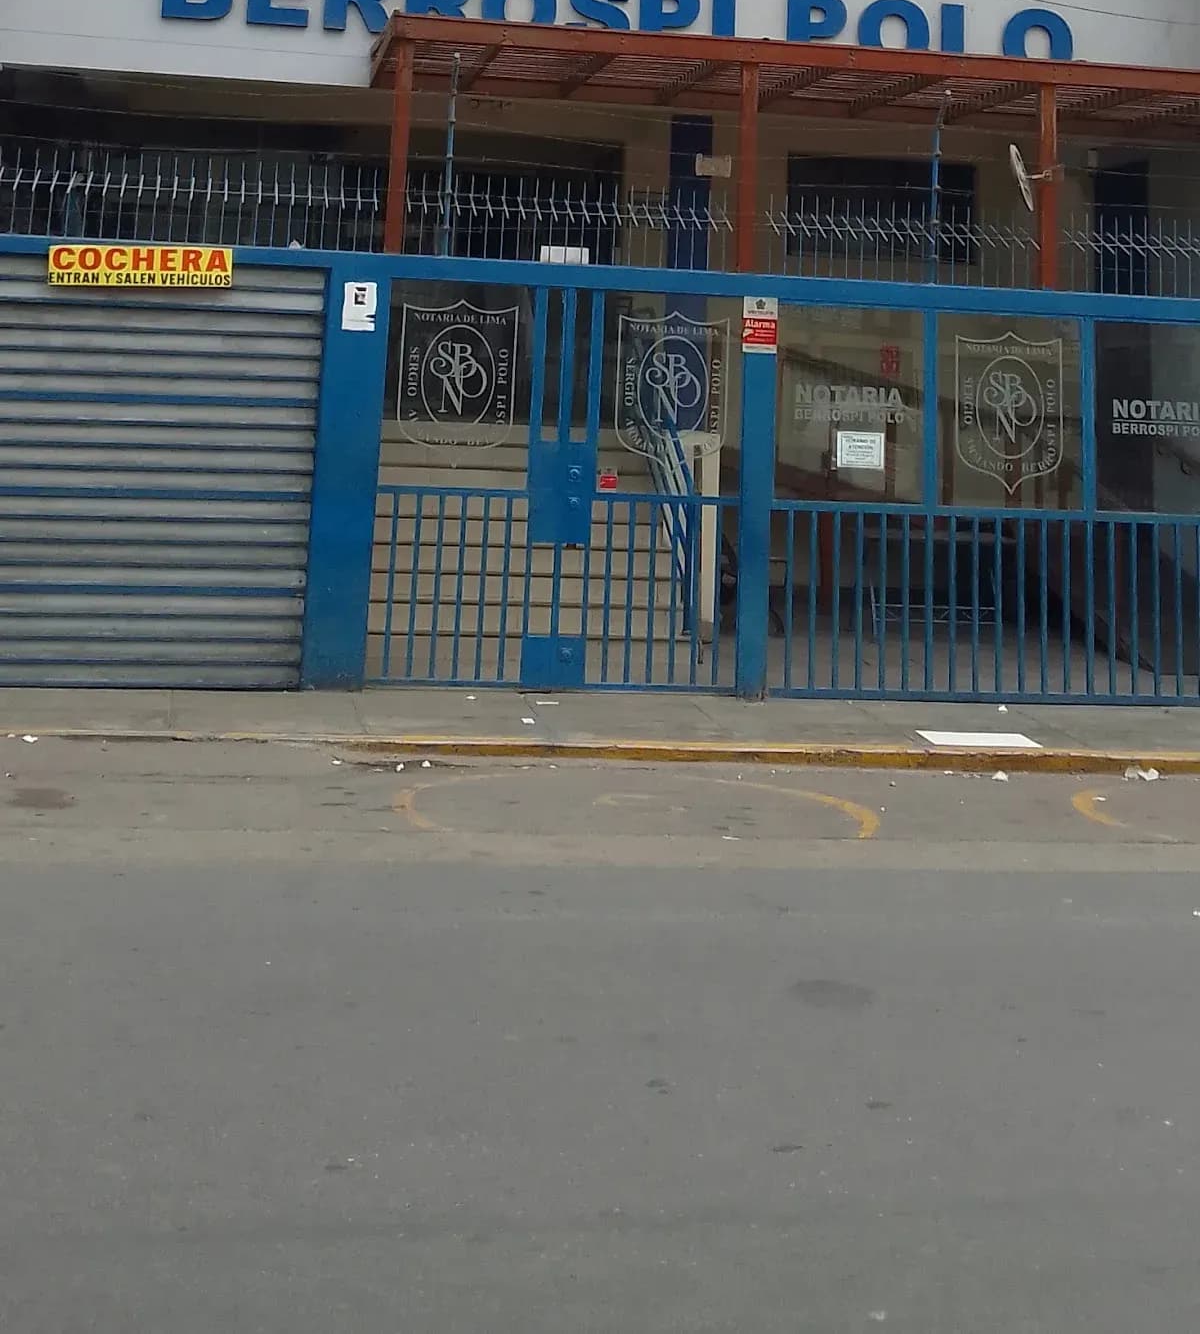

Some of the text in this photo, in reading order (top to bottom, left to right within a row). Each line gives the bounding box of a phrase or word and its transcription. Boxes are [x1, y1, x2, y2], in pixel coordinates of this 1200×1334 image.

[52, 247, 228, 272] COCHERA
[49, 271, 100, 284] ENTRAN
[104, 272, 112, 284] Y
[116, 272, 155, 285] SALEN
[414, 312, 507, 326] NOTARIA DE LIMA
[745, 318, 776, 330] Alarma
[407, 346, 421, 397] SERGIO
[496, 348, 509, 385] POLO
[624, 357, 636, 407] SERGIO
[711, 358, 722, 395] POLO
[795, 383, 904, 406] NOTARIA
[1112, 422, 1179, 437] BERROSPI
